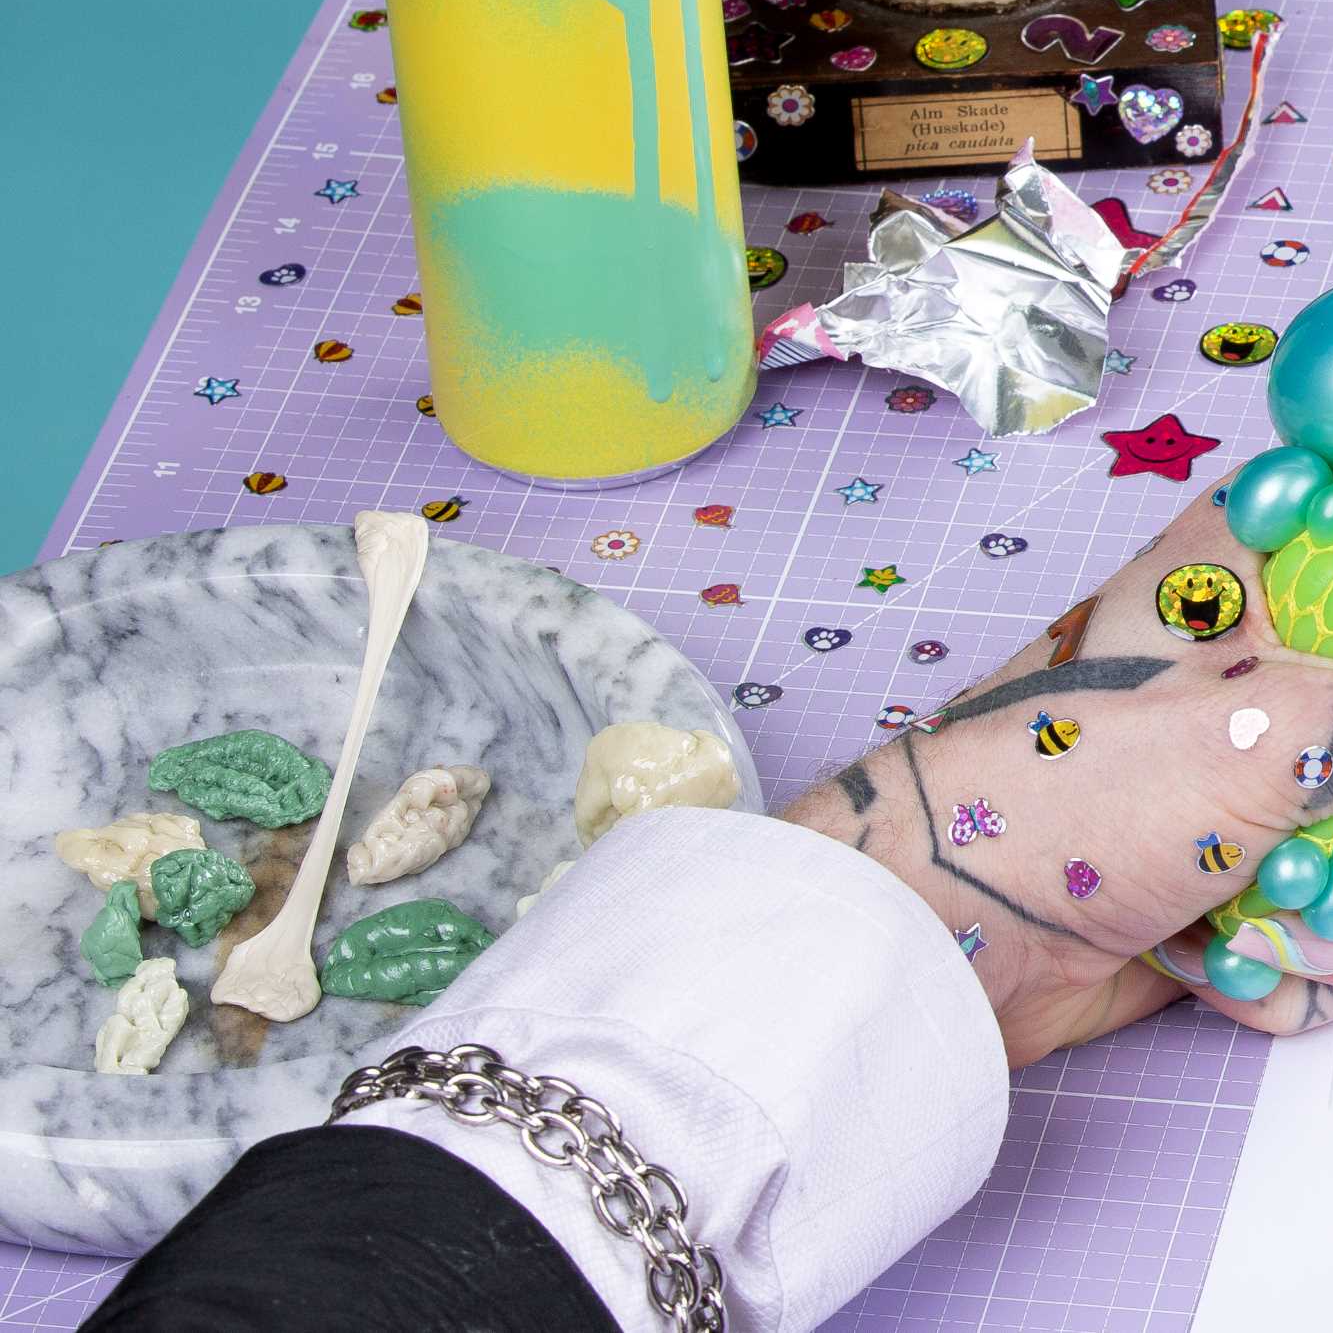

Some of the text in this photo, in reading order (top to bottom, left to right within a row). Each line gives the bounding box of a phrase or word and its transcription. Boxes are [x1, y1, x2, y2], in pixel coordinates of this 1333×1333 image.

[909, 103, 1009, 121] Alm Skade
[911, 119, 1006, 139] (Husskade)
[312, 142, 340, 161] 15
[903, 136, 1015, 156] pica caudata
[273, 217, 302, 235] 14
[234, 295, 263, 315] 13
[153, 460, 182, 478] 11
